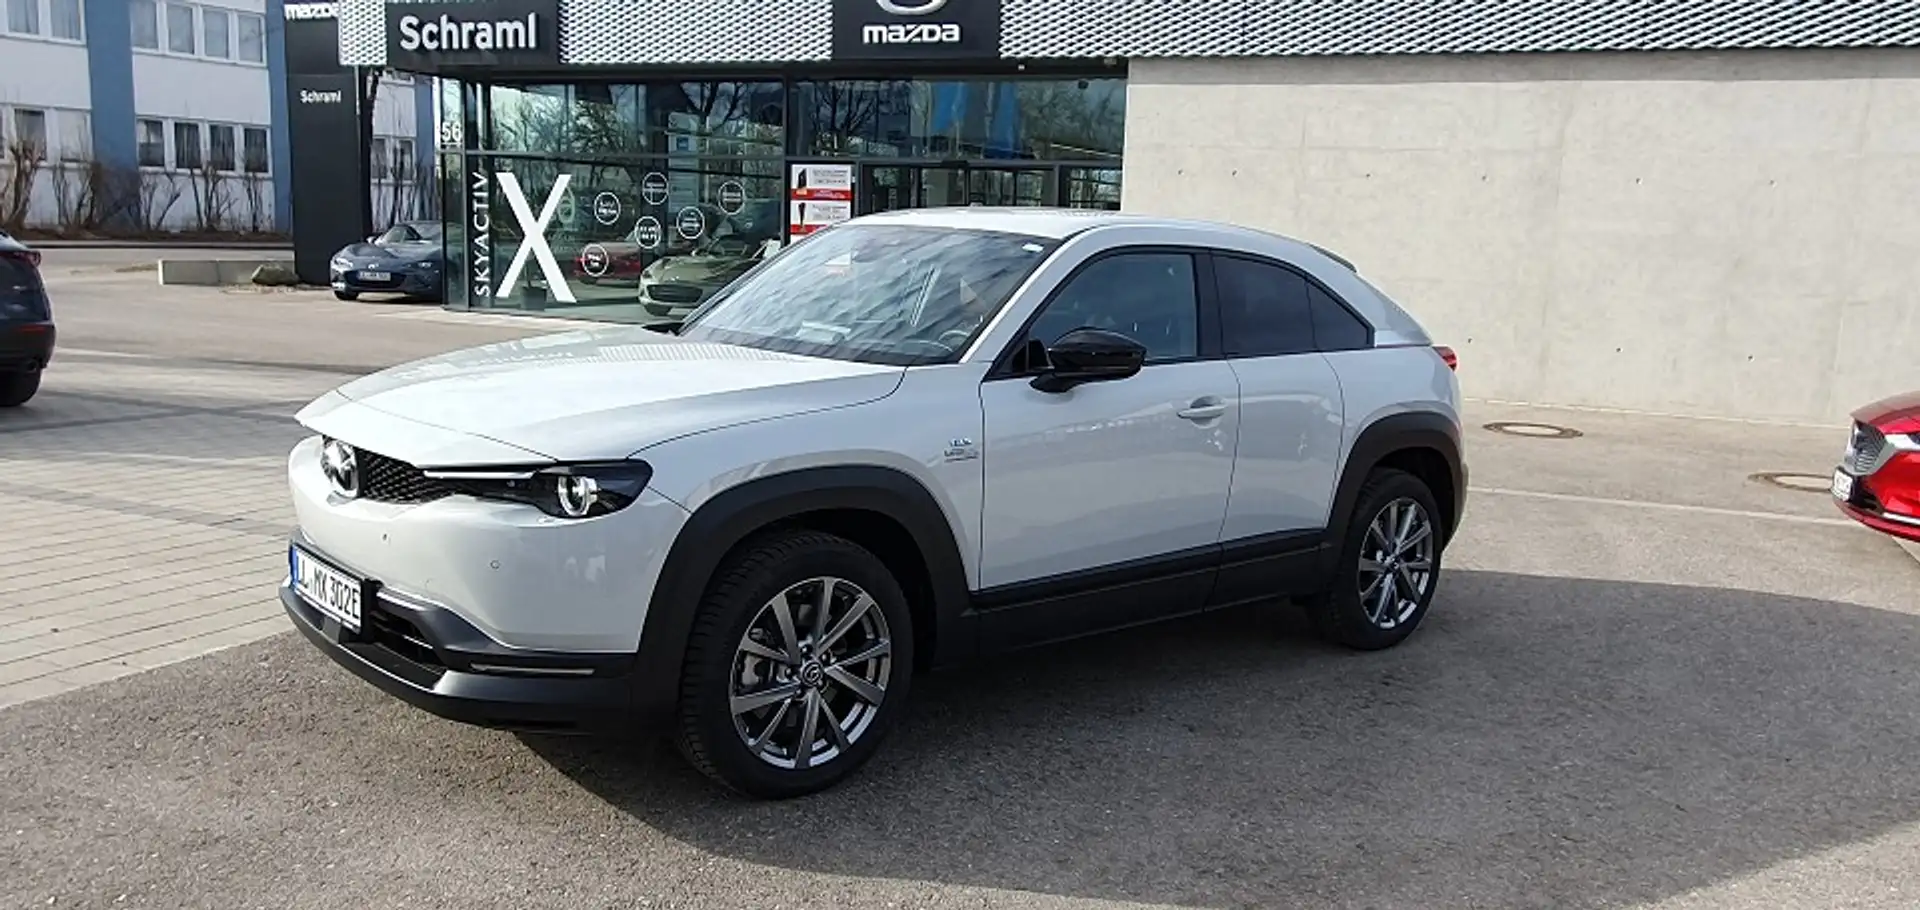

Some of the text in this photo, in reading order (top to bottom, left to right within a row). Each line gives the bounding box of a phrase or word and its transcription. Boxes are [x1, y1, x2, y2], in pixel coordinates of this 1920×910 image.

[400, 12, 537, 50] Schraml
[863, 24, 960, 43] mazda
[300, 90, 341, 104] Schraml
[442, 121, 462, 142] 56
[472, 172, 491, 297] SKYACTIV
[495, 172, 577, 303] X
